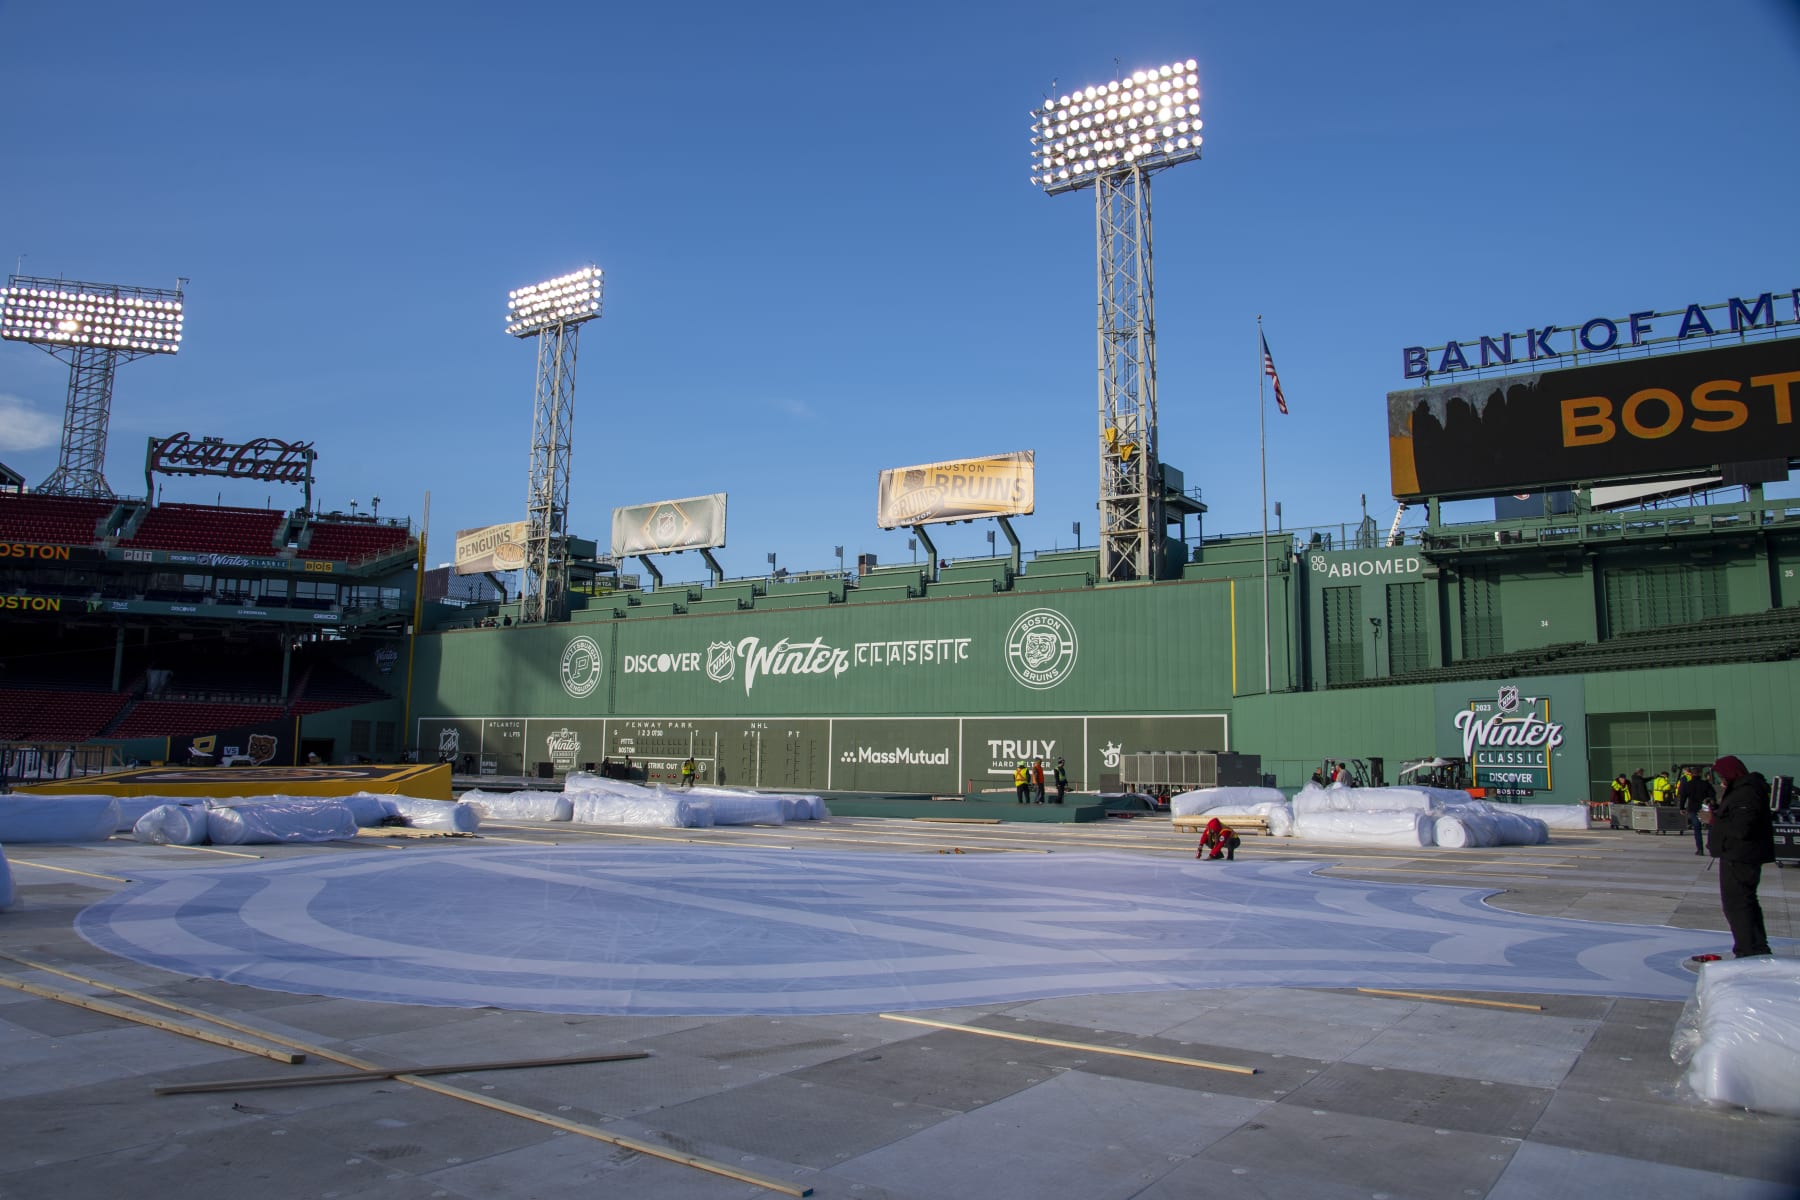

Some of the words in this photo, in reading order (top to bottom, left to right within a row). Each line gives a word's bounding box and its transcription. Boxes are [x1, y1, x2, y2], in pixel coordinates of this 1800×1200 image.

[1403, 326, 1559, 379] BANK
[1579, 310, 1654, 352] OF
[935, 473, 1027, 502] BRUINS
[458, 529, 511, 560] PENGUINS
[124, 551, 152, 561] PIT
[305, 561, 332, 572] BOS
[1328, 558, 1420, 578] ABIOMED
[1021, 616, 1061, 632] BOSTON
[565, 642, 598, 661] PITTSBURGH
[624, 653, 702, 673] DISCOVER
[712, 651, 730, 674] NHL
[736, 636, 849, 697] Winter
[855, 639, 971, 665] CLASSIC
[1023, 668, 1060, 681] BRUINS
[566, 679, 594, 692] PENGUINS
[1475, 704, 1491, 712] 2023
[625, 721, 662, 729] FENWAY
[1454, 711, 1563, 763] Winter
[546, 736, 581, 760] Winter
[858, 746, 949, 765] MassMutual
[987, 740, 1056, 760] TRULY
[1478, 751, 1544, 764] CLASSIC
[1489, 773, 1533, 783] DISCOVER
[1496, 788, 1526, 796] BOSTON
